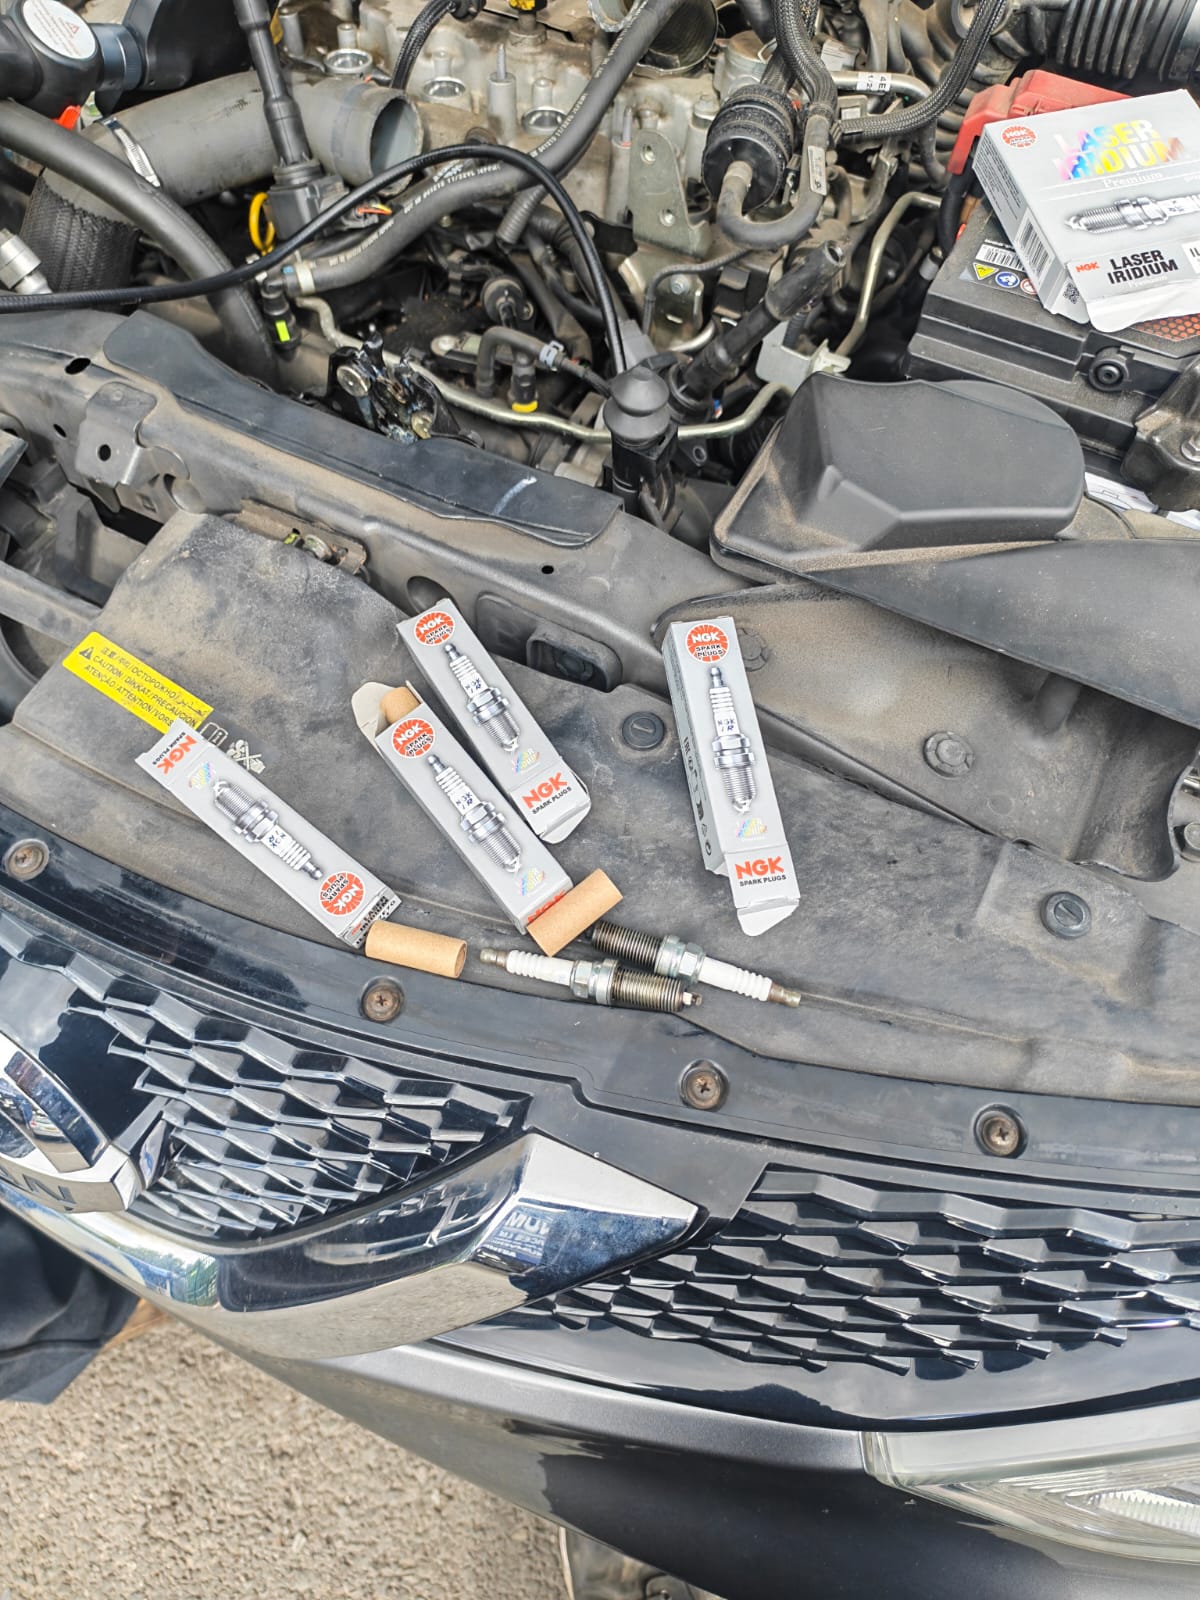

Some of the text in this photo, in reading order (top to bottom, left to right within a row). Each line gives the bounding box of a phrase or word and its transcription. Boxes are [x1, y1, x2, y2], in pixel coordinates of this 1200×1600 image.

[1053, 119, 1161, 155] LASER
[1053, 137, 1185, 181] IRIDIUM
[1103, 172, 1163, 189] Premium
[1109, 249, 1165, 270] LASER
[1107, 259, 1179, 284] IRIDIUM
[418, 616, 445, 634] NGK
[691, 631, 720, 644] NGK
[695, 644, 721, 652] SPARK
[92, 655, 123, 679] CAUTION
[115, 686, 153, 712] ATTENTION
[397, 722, 424, 745] NGK
[404, 732, 428, 751] SPARK
[157, 735, 198, 775] NGK
[408, 737, 432, 756] PLUGS
[522, 772, 567, 809] NGK
[532, 786, 572, 815] SPARK PLUGS
[735, 855, 785, 880] NGK
[322, 875, 344, 898] PLUGS
[327, 879, 349, 902] SPARK
[739, 874, 787, 887] SPARK PLUGS
[332, 882, 362, 912] NGK
